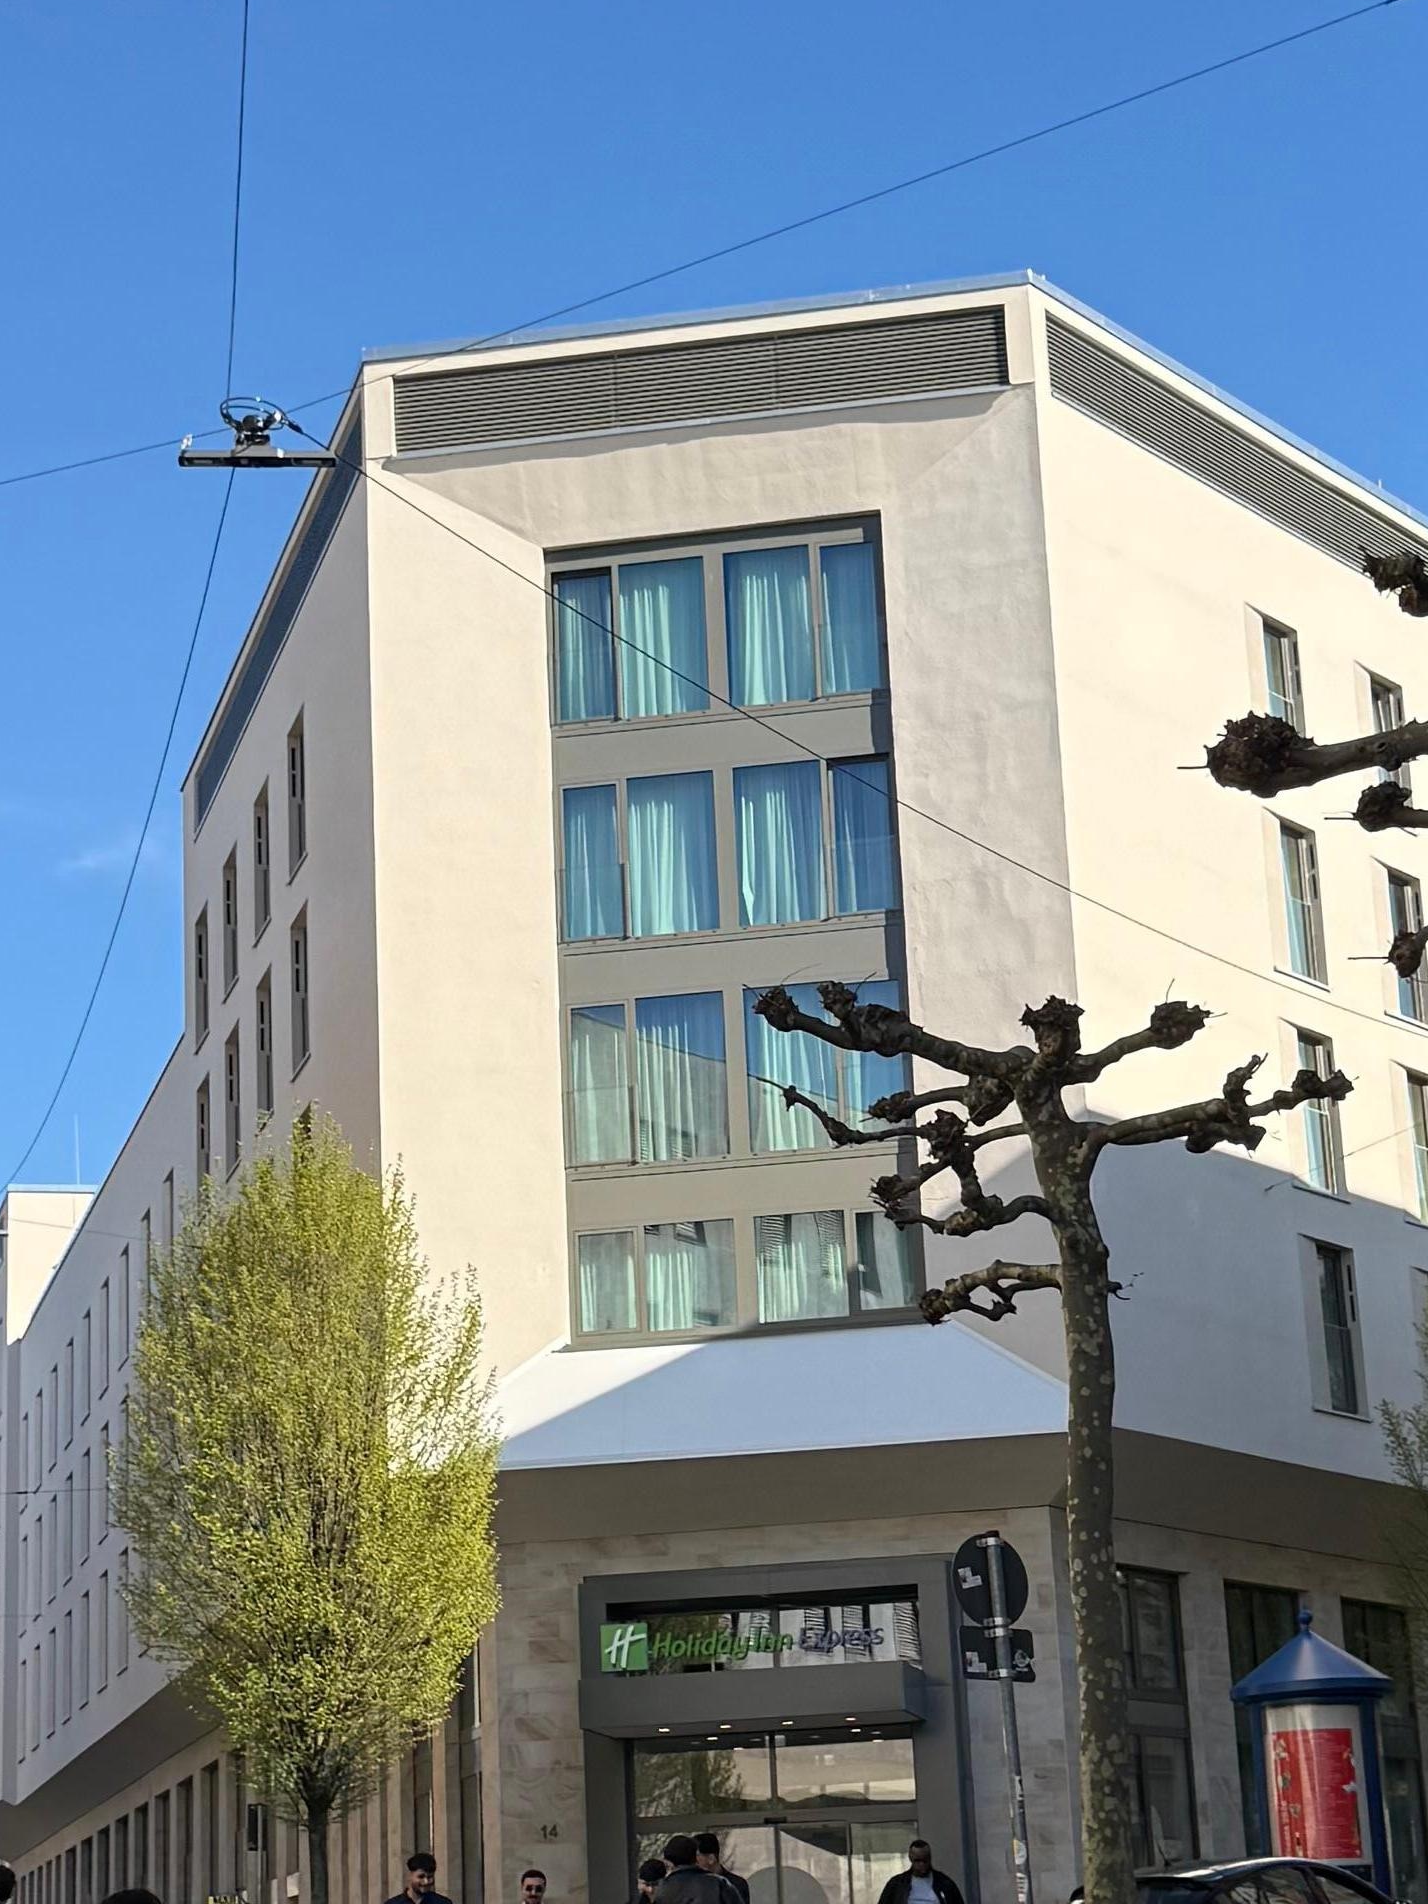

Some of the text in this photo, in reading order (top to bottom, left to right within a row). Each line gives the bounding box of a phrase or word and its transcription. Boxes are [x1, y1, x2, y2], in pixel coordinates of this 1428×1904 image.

[652, 1628, 751, 1661] Holiday
[754, 1627, 794, 1654] Inn
[798, 1627, 885, 1654] Express
[540, 1824, 558, 1840] 14
